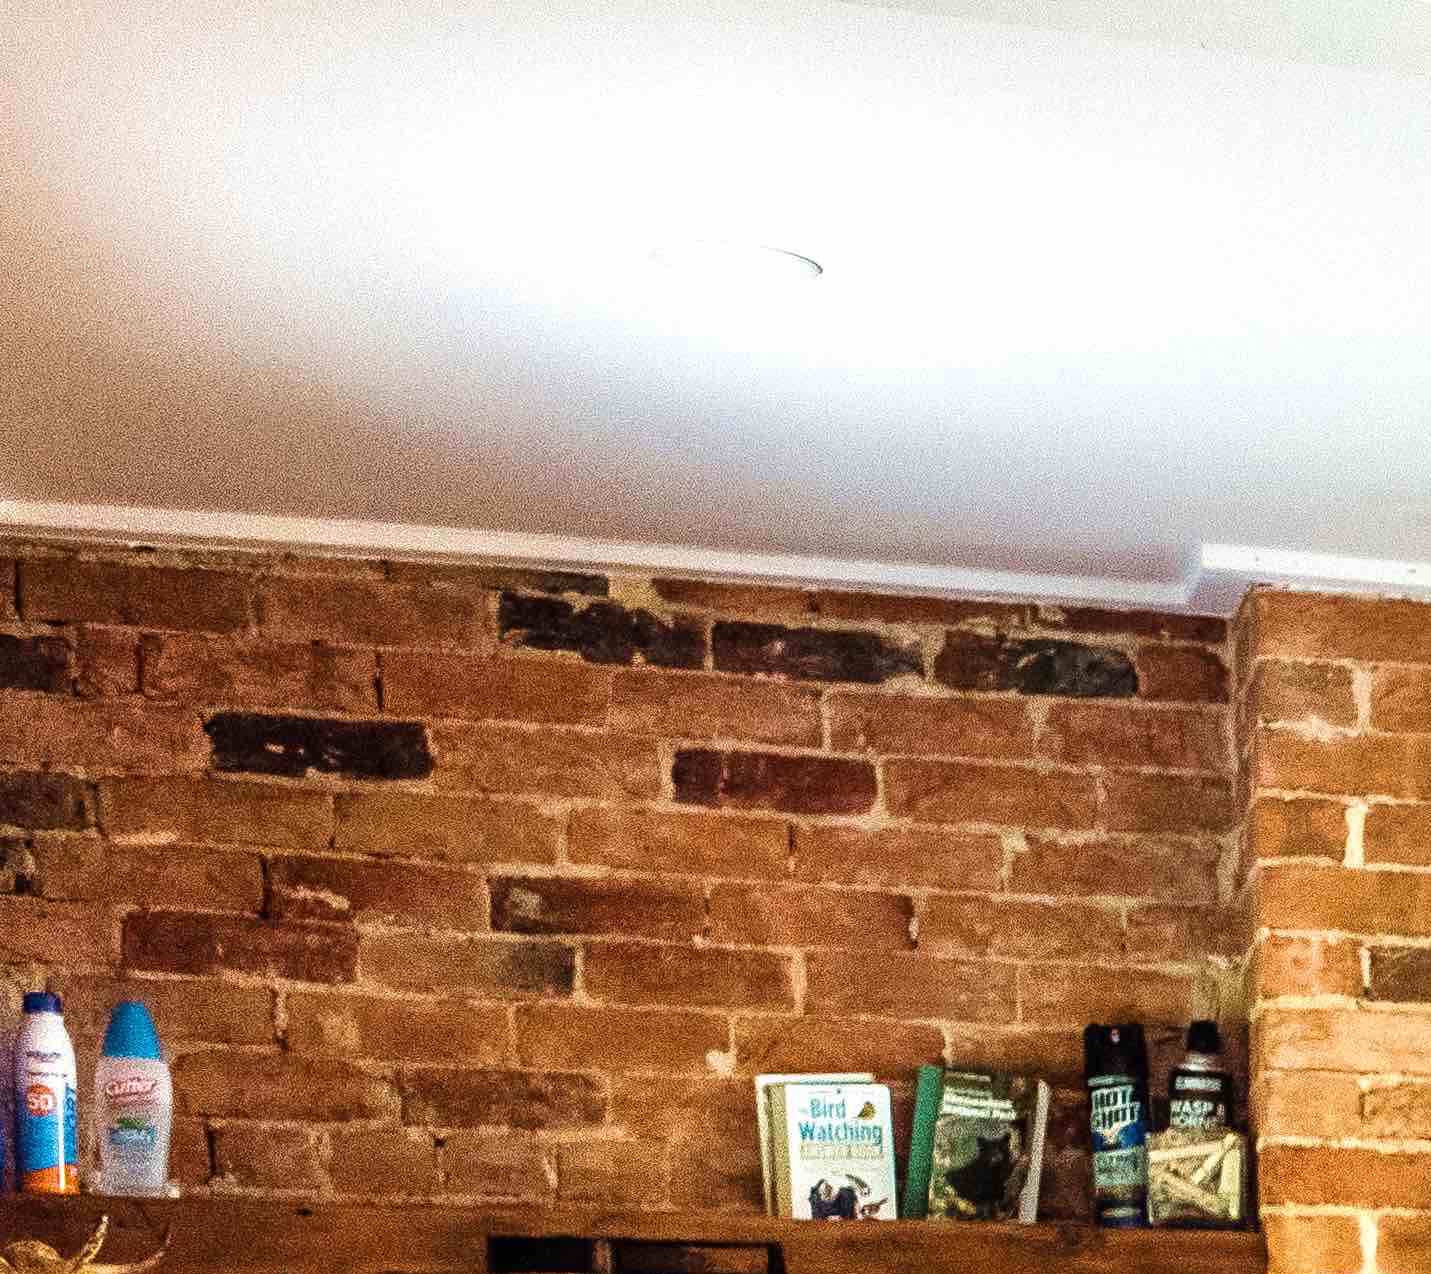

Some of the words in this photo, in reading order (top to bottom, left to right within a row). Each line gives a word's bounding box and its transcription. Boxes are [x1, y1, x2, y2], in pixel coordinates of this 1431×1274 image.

[810, 1098, 846, 1119] Bird
[1091, 1085, 1134, 1110] HOT
[1170, 1100, 1214, 1117] WASP
[799, 1121, 884, 1153] Watching
